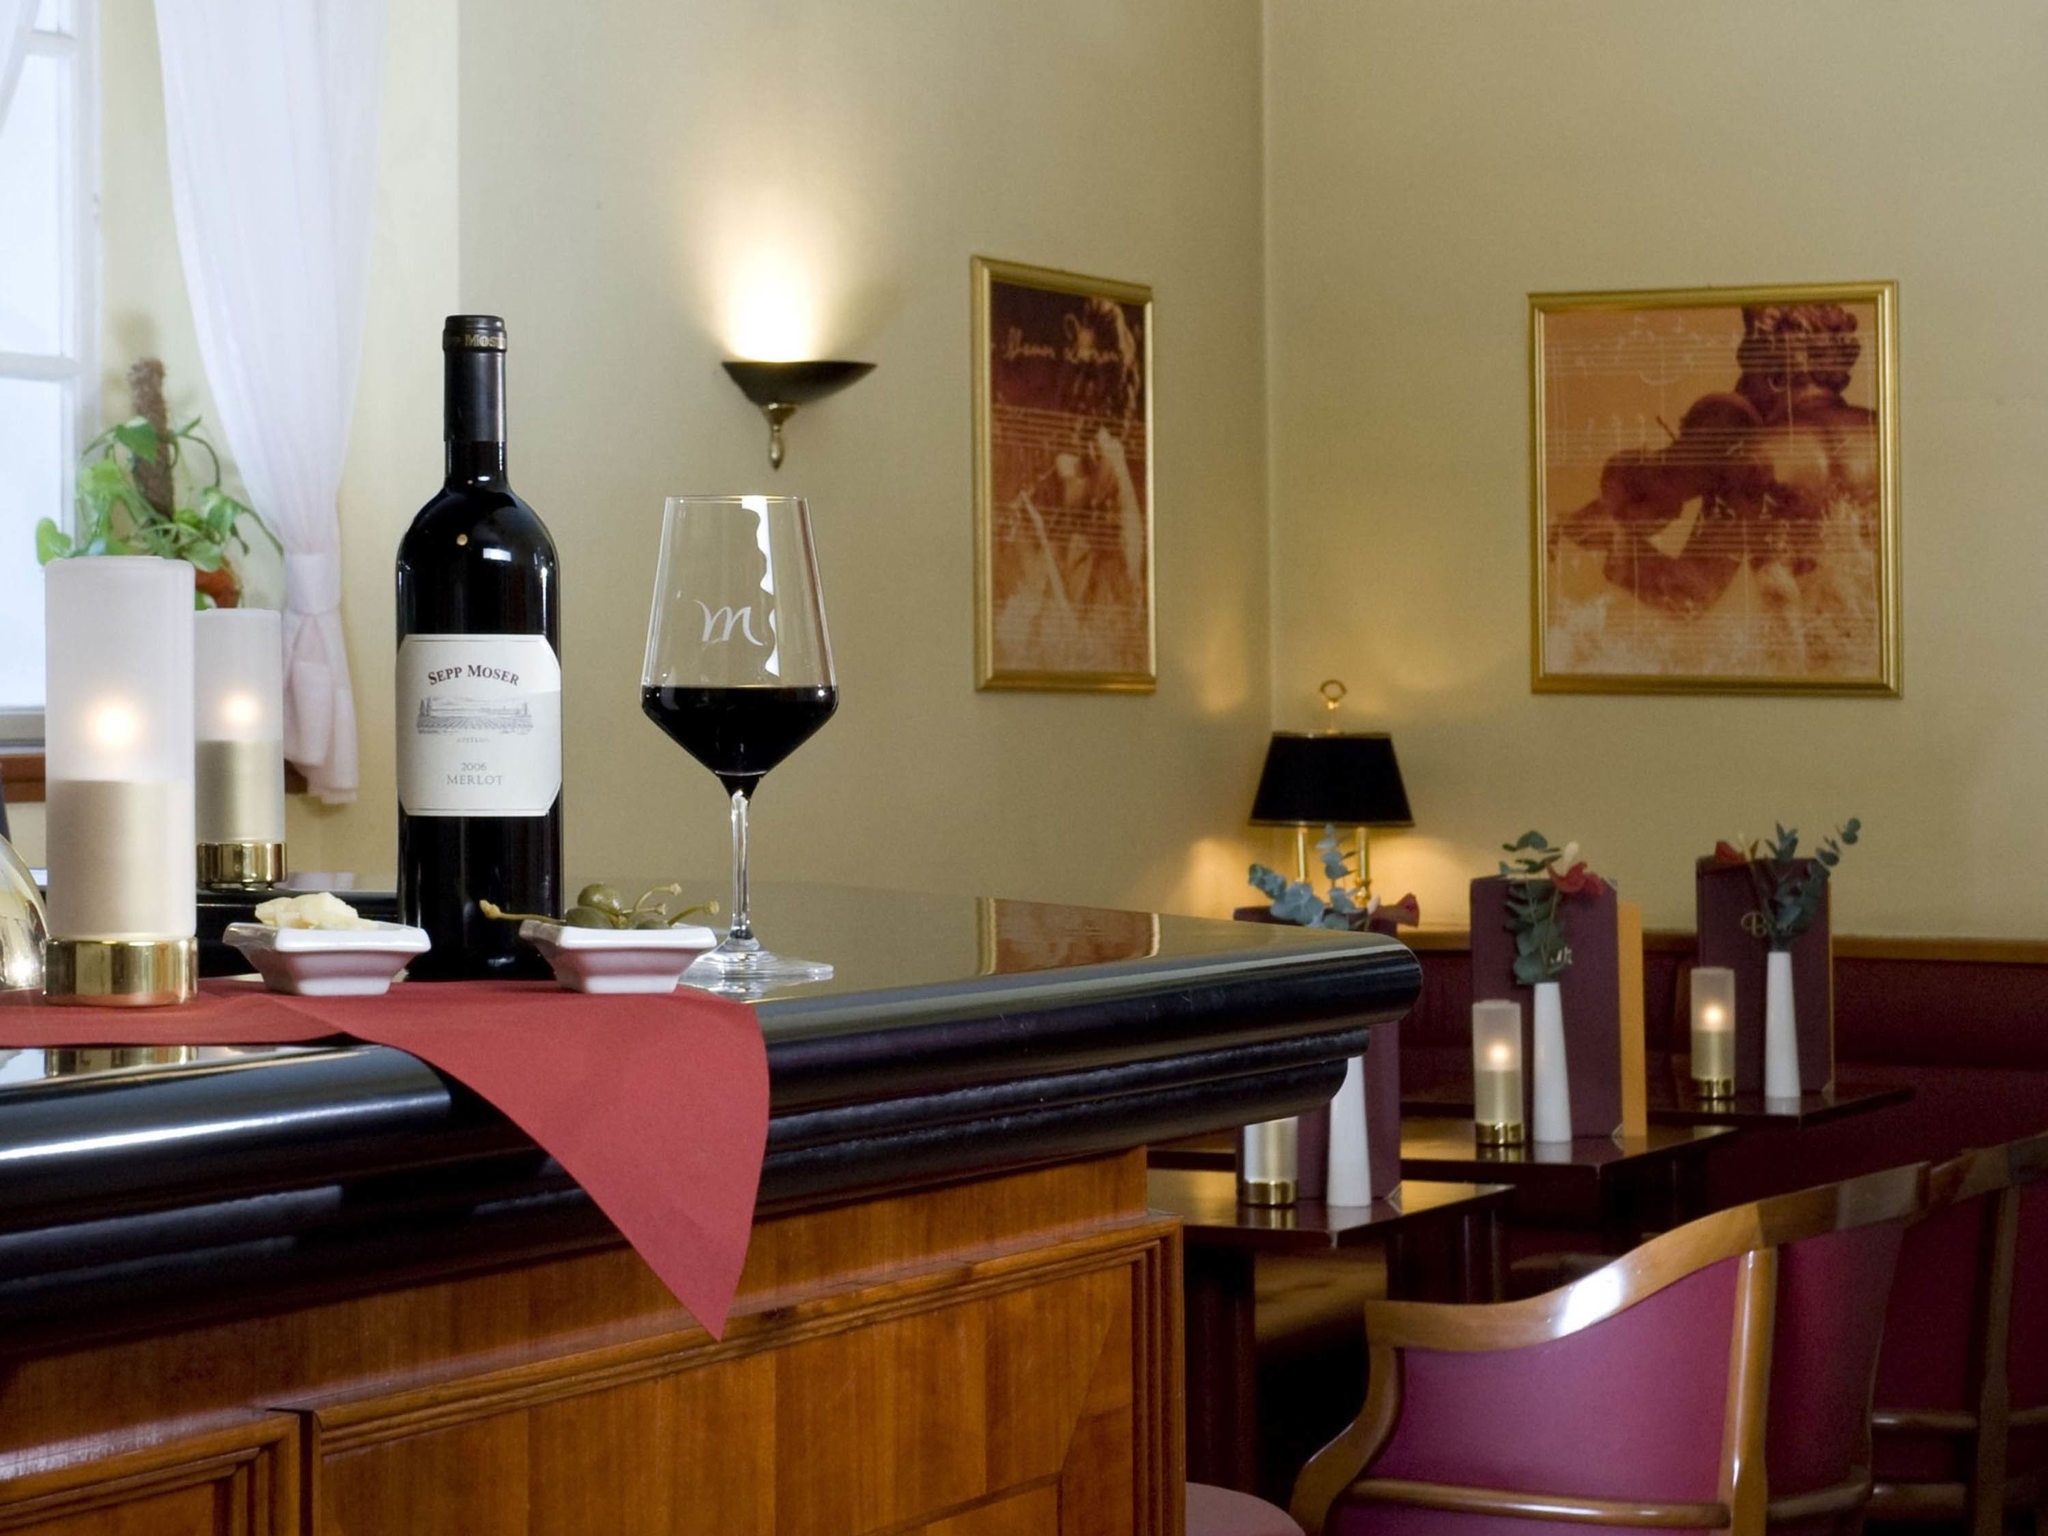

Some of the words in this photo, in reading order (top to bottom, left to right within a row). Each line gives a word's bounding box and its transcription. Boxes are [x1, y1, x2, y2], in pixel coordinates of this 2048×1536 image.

[427, 666, 463, 685] SEPP
[467, 664, 520, 686] MOSER
[460, 762, 488, 772] 2006
[446, 774, 504, 785] MERLOT
